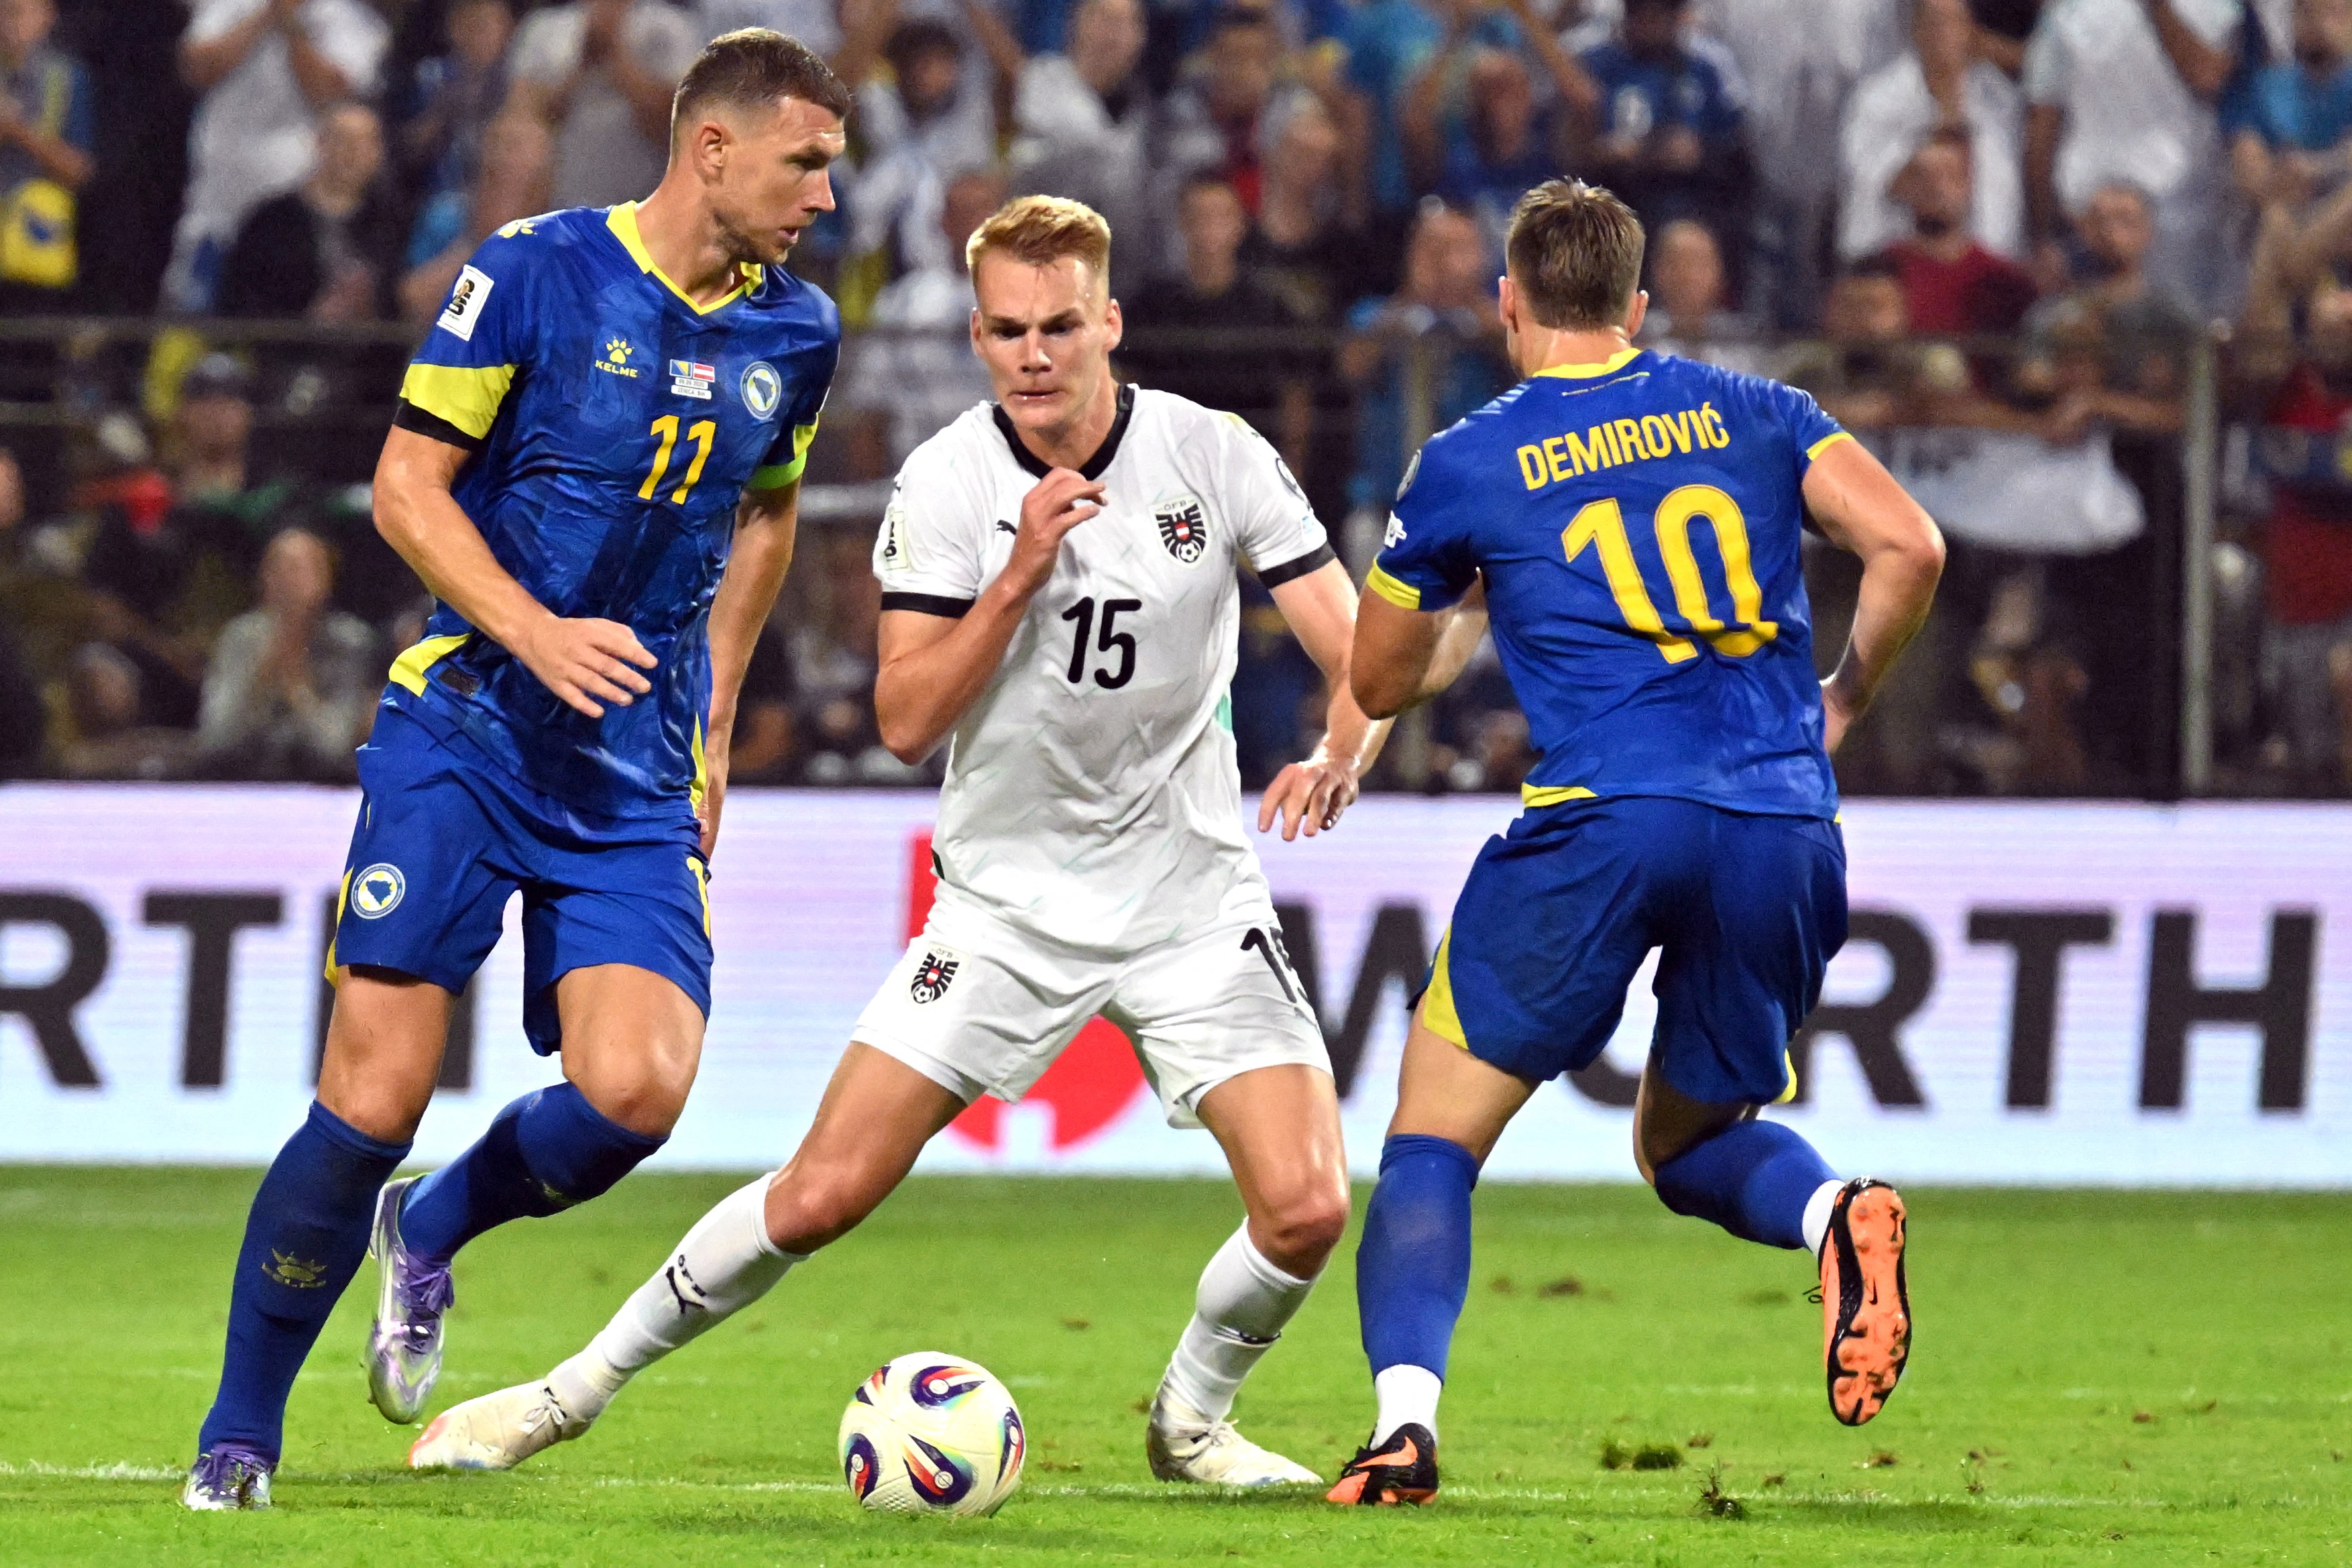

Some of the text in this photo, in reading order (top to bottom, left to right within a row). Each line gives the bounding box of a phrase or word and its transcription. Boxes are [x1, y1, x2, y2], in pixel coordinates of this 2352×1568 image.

[596, 359, 638, 378] KELME
[638, 414, 716, 505] 11
[1516, 401, 1730, 491] DEMIROVIĆ
[1561, 484, 1779, 665] 10
[1062, 596, 1143, 689] 15
